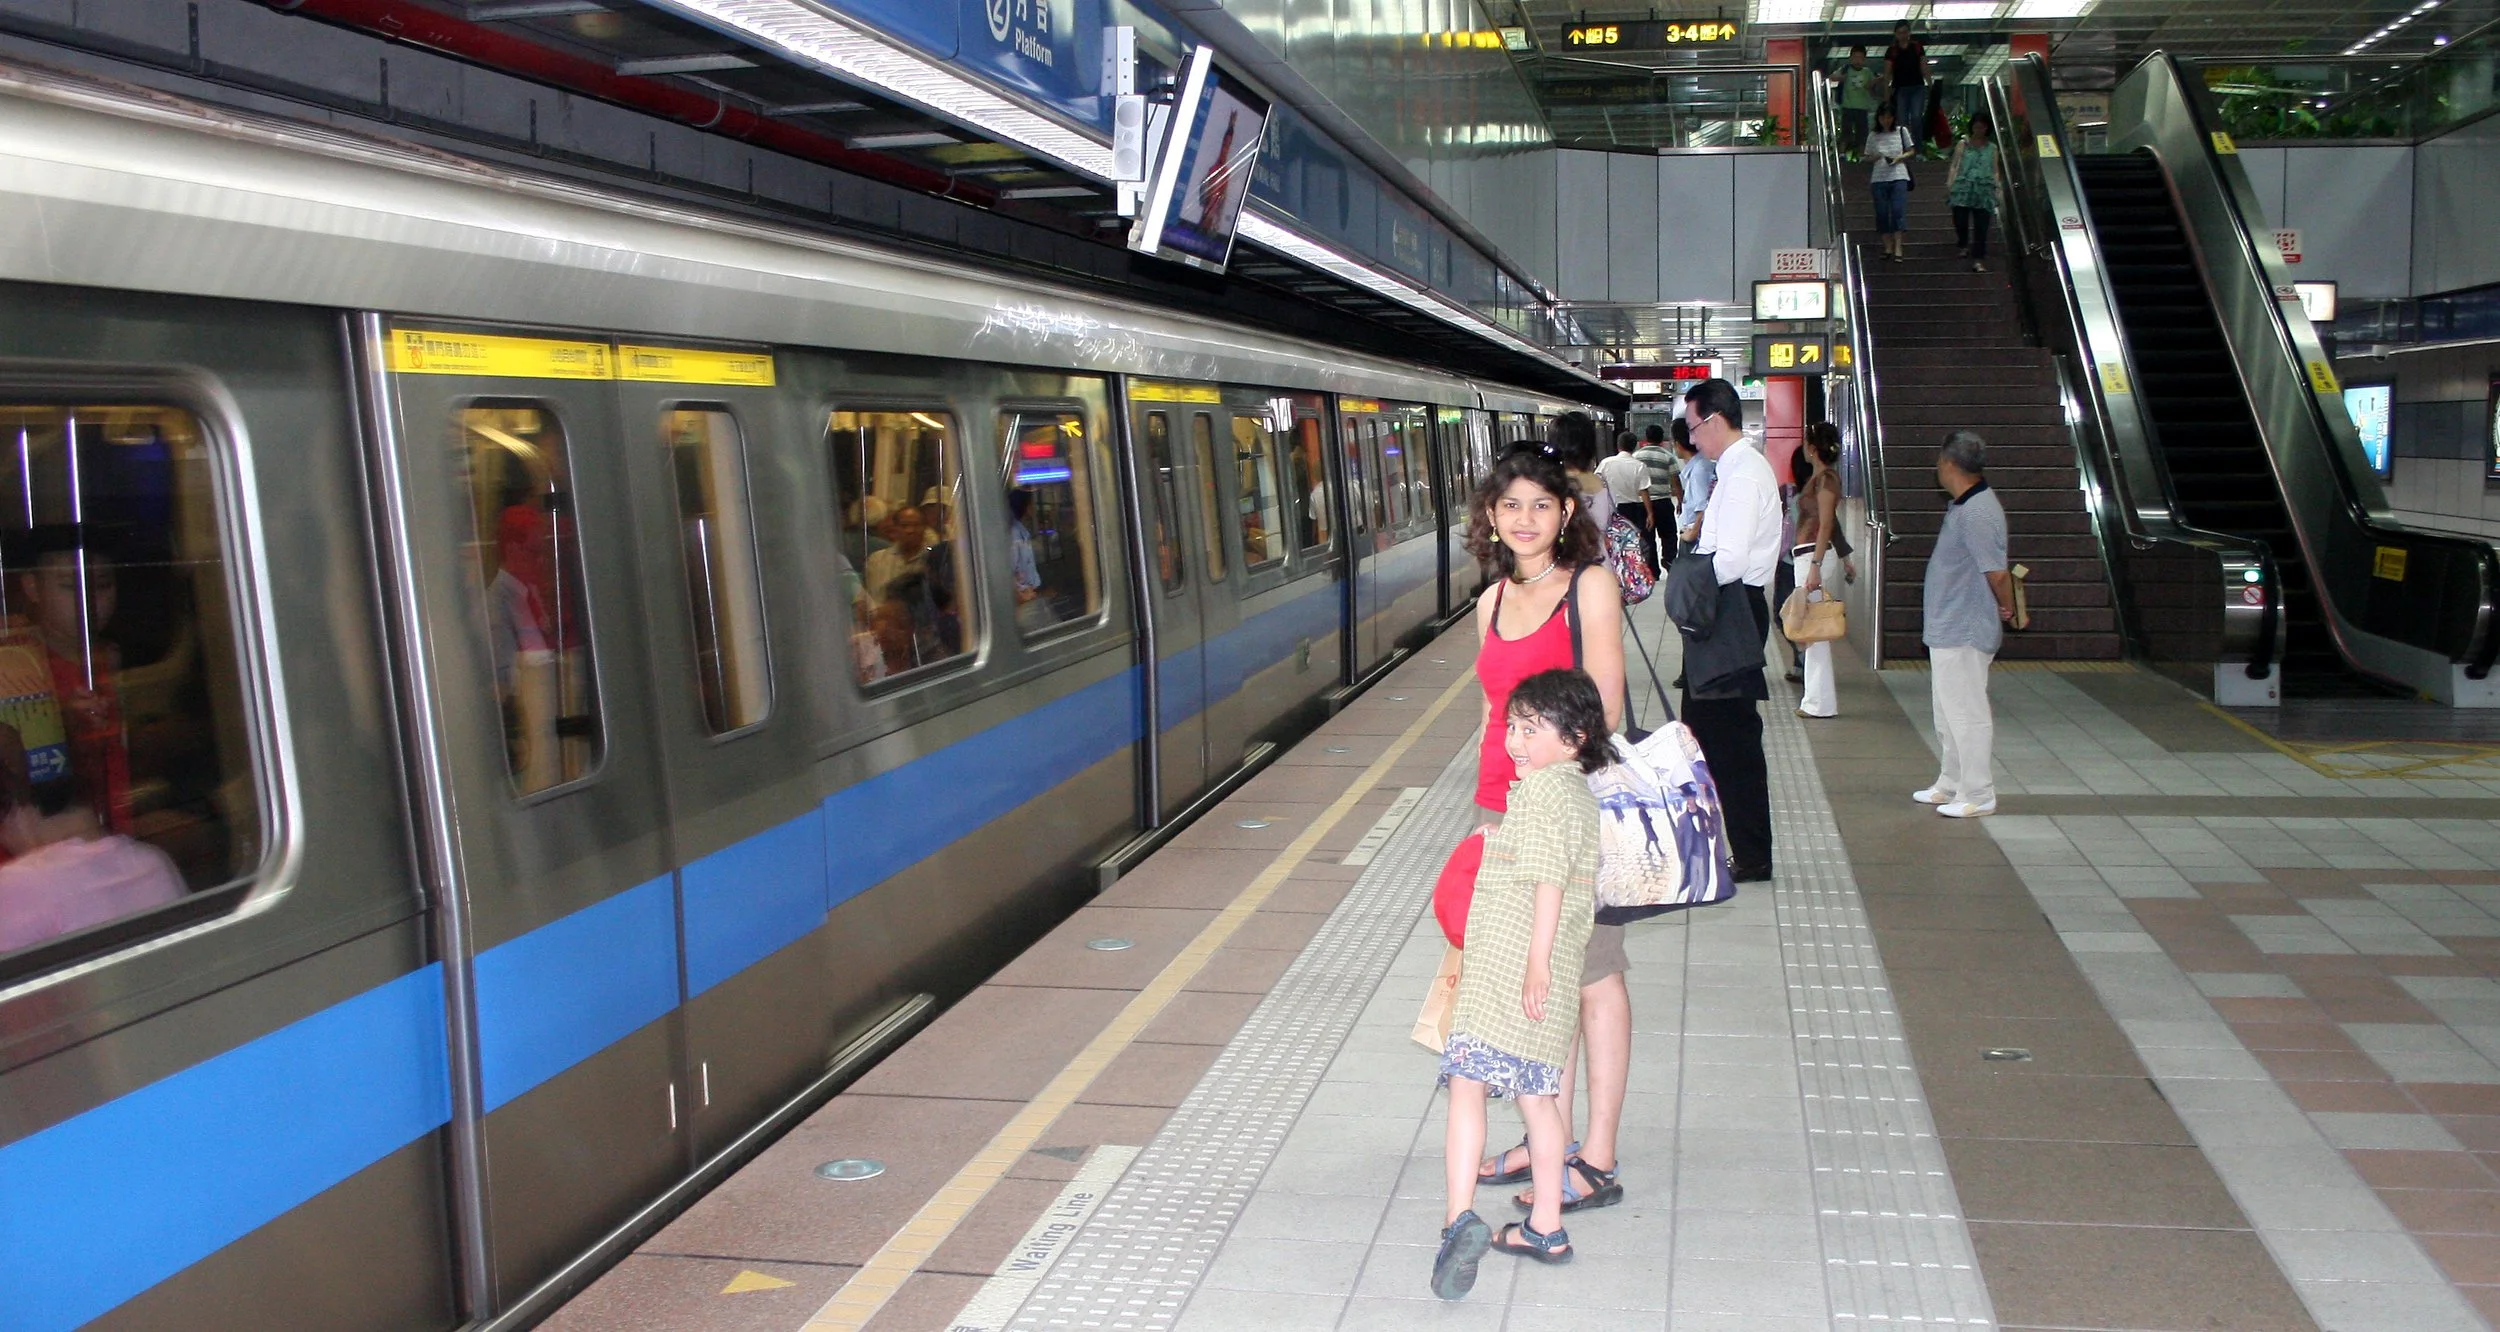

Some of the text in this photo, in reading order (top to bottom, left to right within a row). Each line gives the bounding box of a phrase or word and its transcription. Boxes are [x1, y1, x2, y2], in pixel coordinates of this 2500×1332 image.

[1015, 27, 1052, 67] Platform
[1007, 1192, 1094, 1272] Waiting Line
